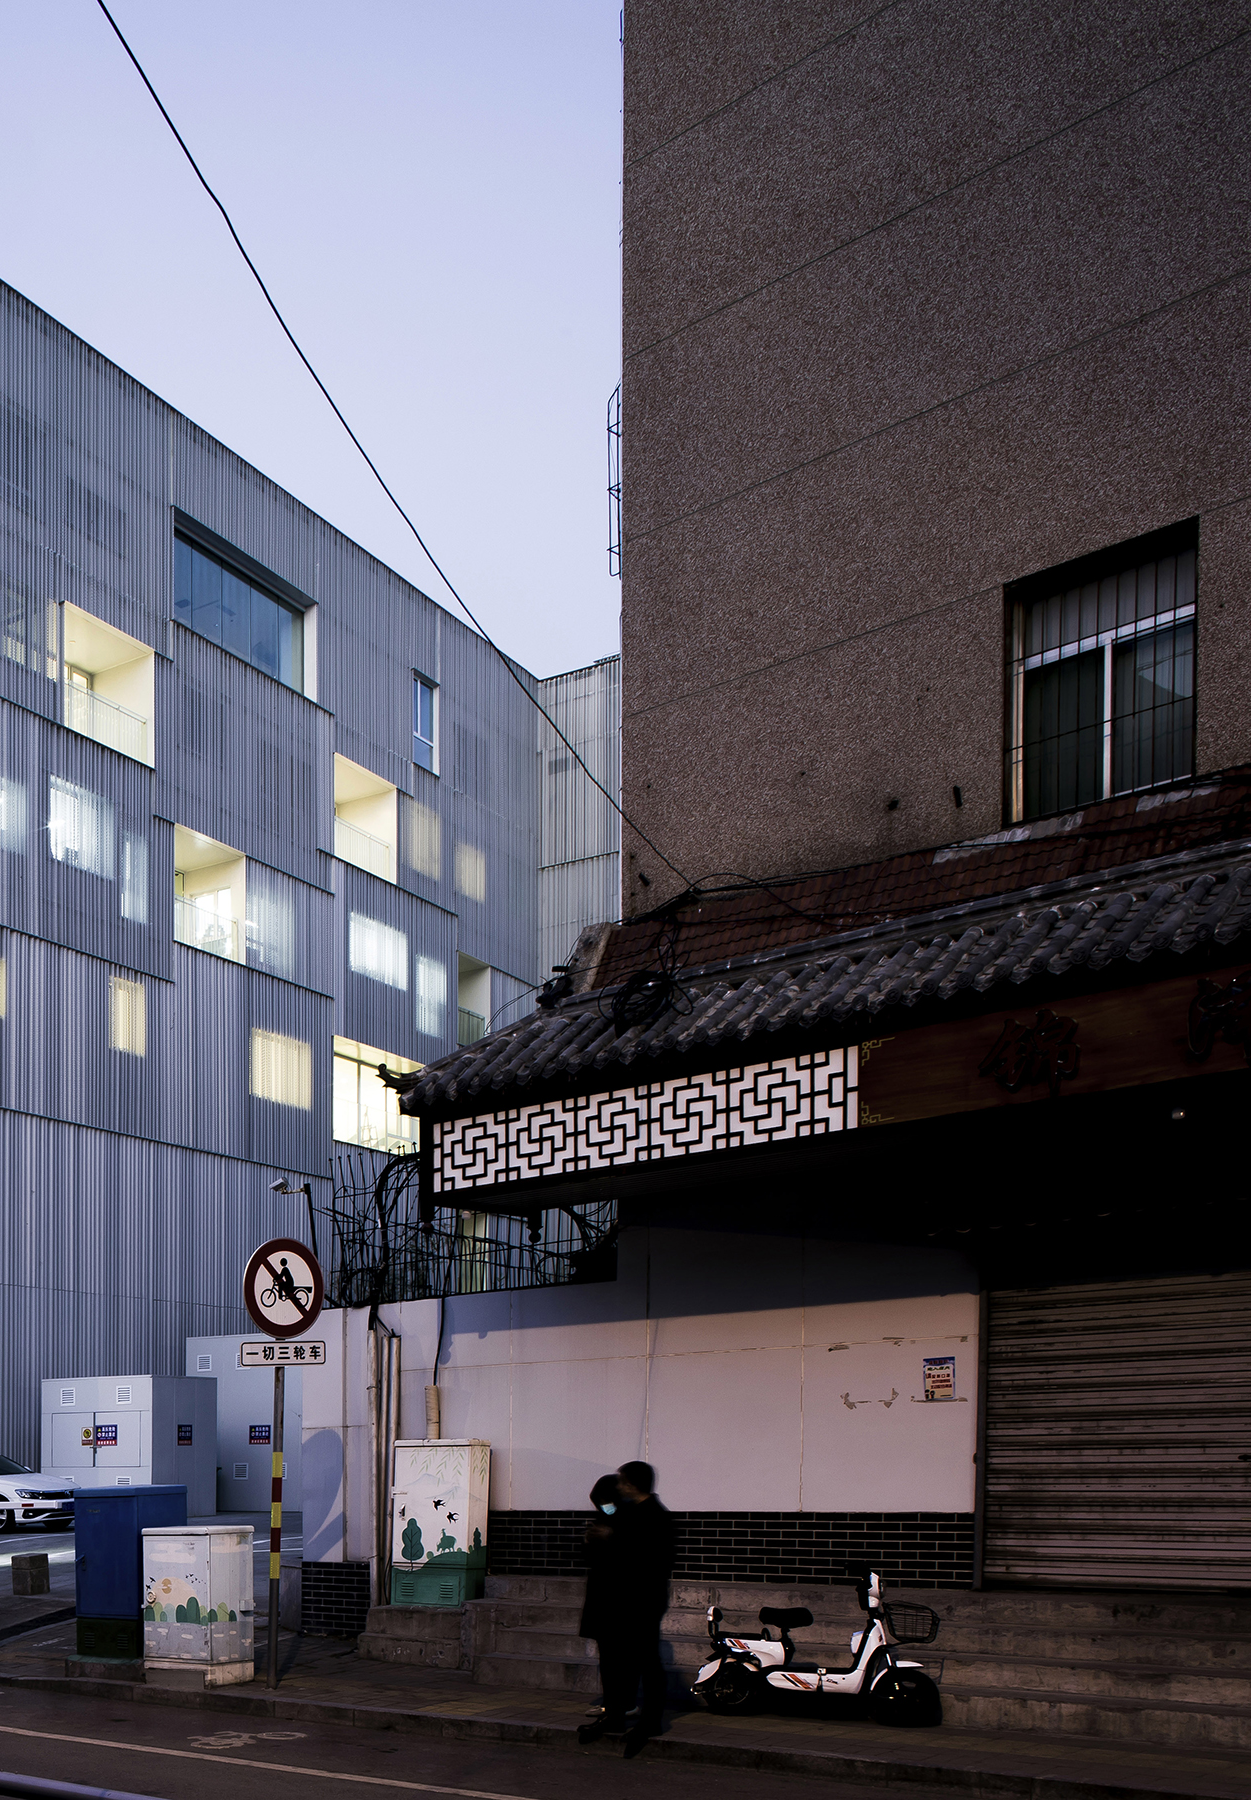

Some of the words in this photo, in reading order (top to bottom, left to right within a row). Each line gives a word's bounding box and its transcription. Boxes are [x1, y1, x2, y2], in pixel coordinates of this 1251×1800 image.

[246, 1345, 322, 1361] 一切三轮车
